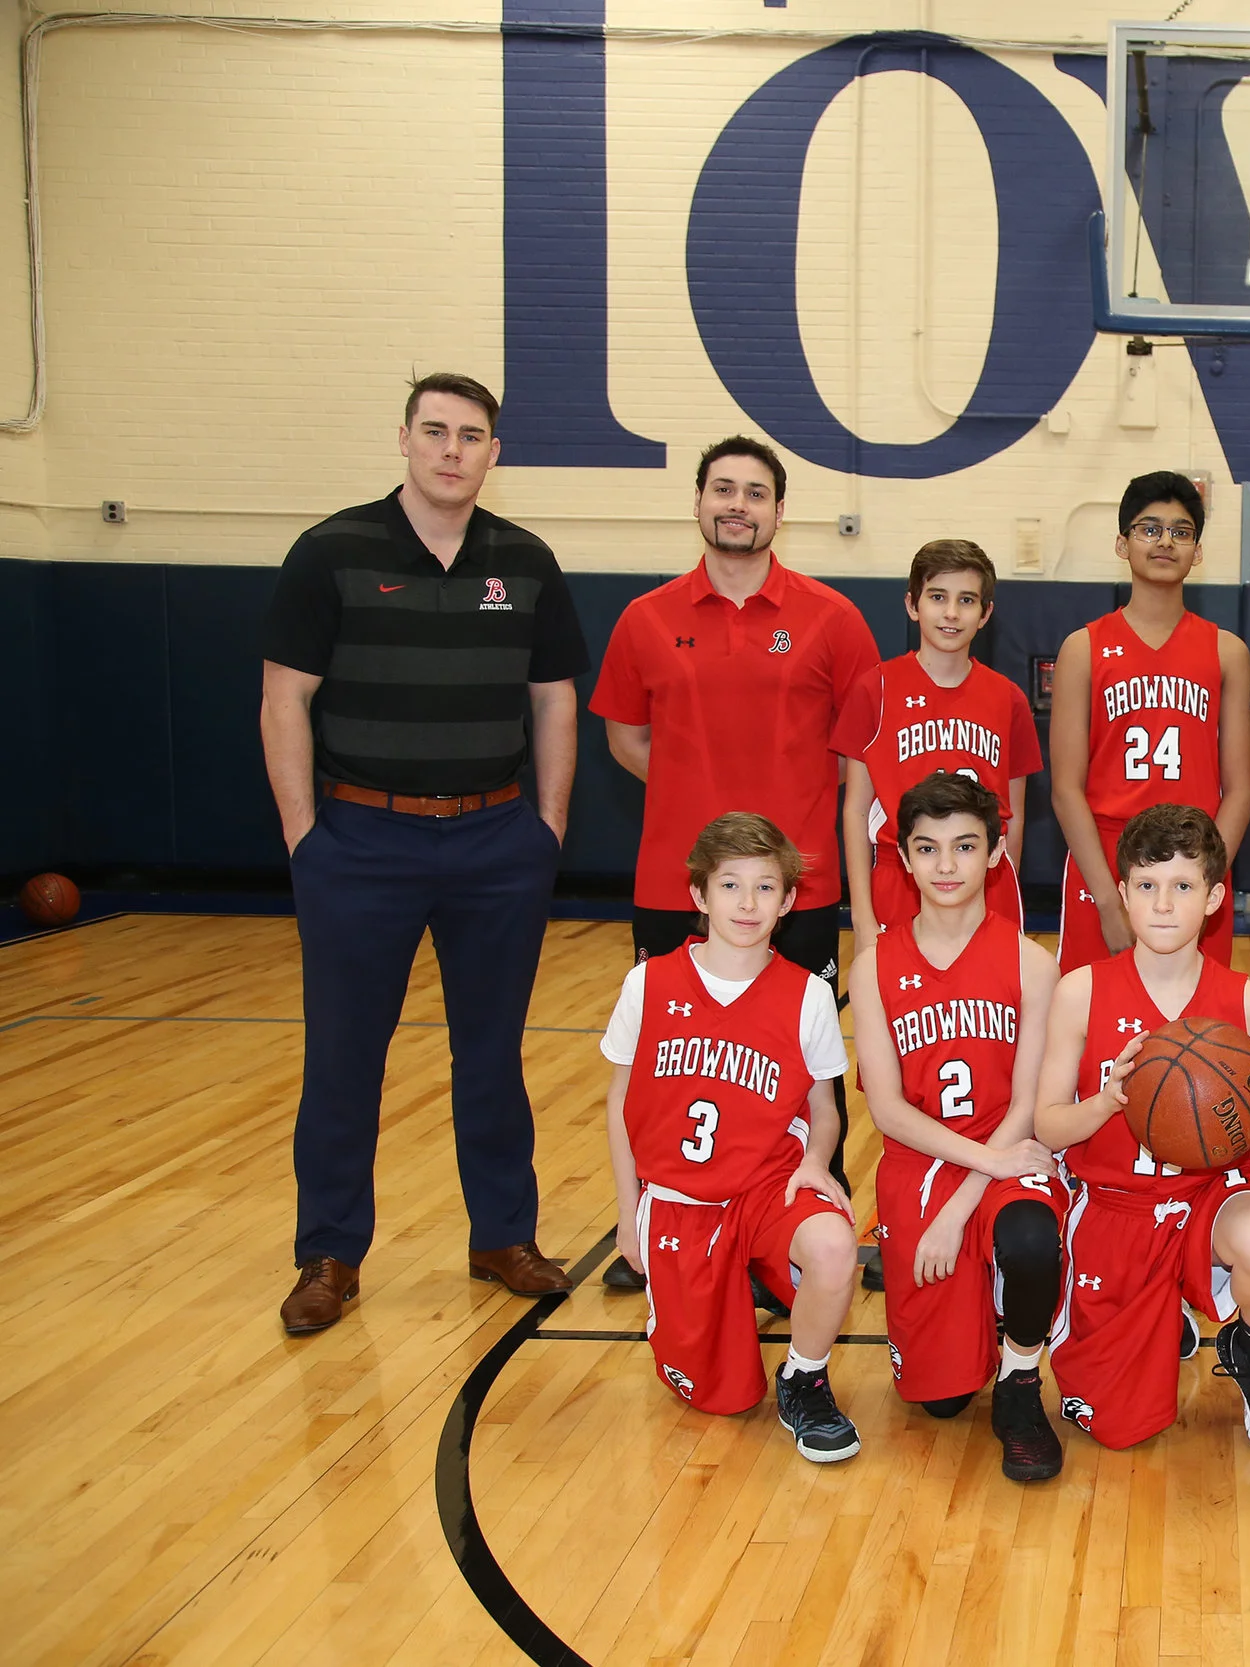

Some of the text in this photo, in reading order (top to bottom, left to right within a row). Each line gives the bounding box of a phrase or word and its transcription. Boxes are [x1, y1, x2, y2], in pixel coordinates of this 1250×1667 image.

[479, 603, 513, 611] ATHLETICS
[483, 577, 507, 603] B
[1102, 674, 1210, 723] BROWNING
[896, 717, 1002, 769] BROWNING
[1124, 725, 1182, 781] 24
[891, 998, 1017, 1057] BROWNING
[653, 1036, 782, 1103] BROWNING
[938, 1059, 975, 1119] 2
[680, 1099, 720, 1164] 3
